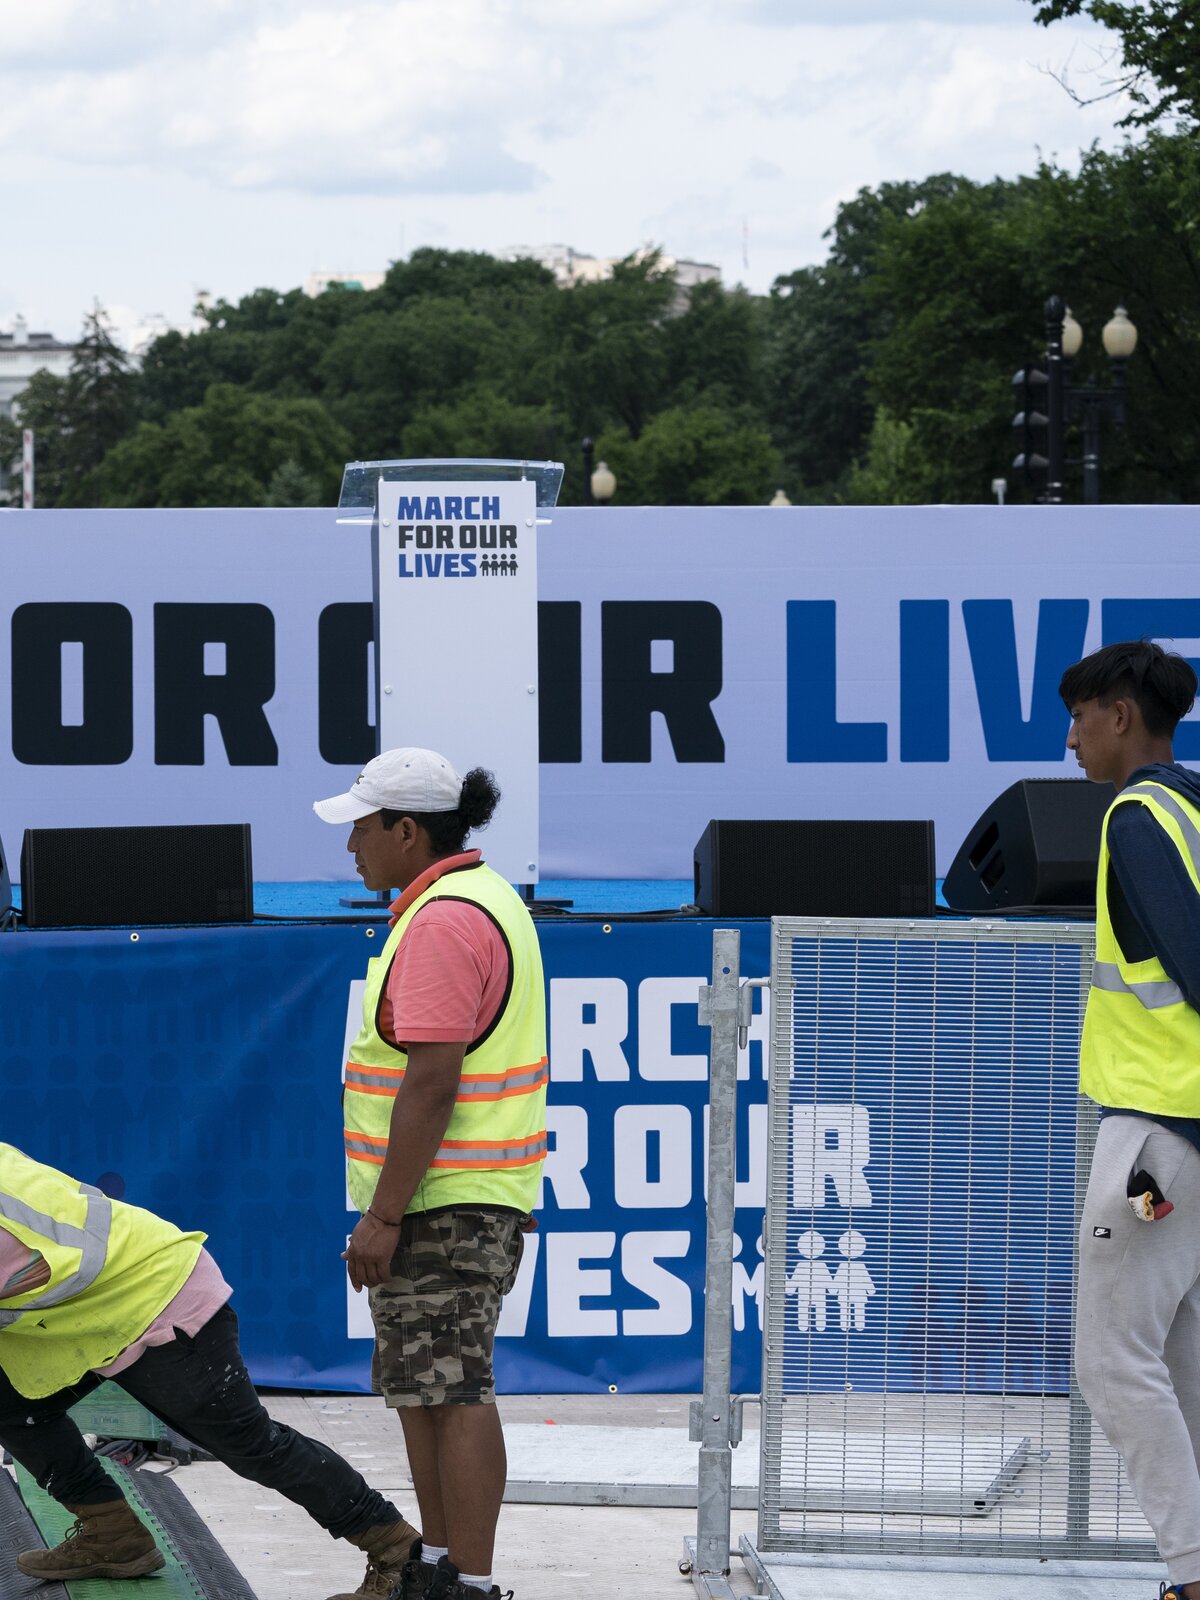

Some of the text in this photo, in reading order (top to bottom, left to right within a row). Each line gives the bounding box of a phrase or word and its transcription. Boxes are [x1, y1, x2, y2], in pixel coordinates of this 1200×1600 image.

[397, 496, 500, 520] MARCH
[398, 525, 518, 549] FOR OUR
[398, 553, 477, 577] LIVES
